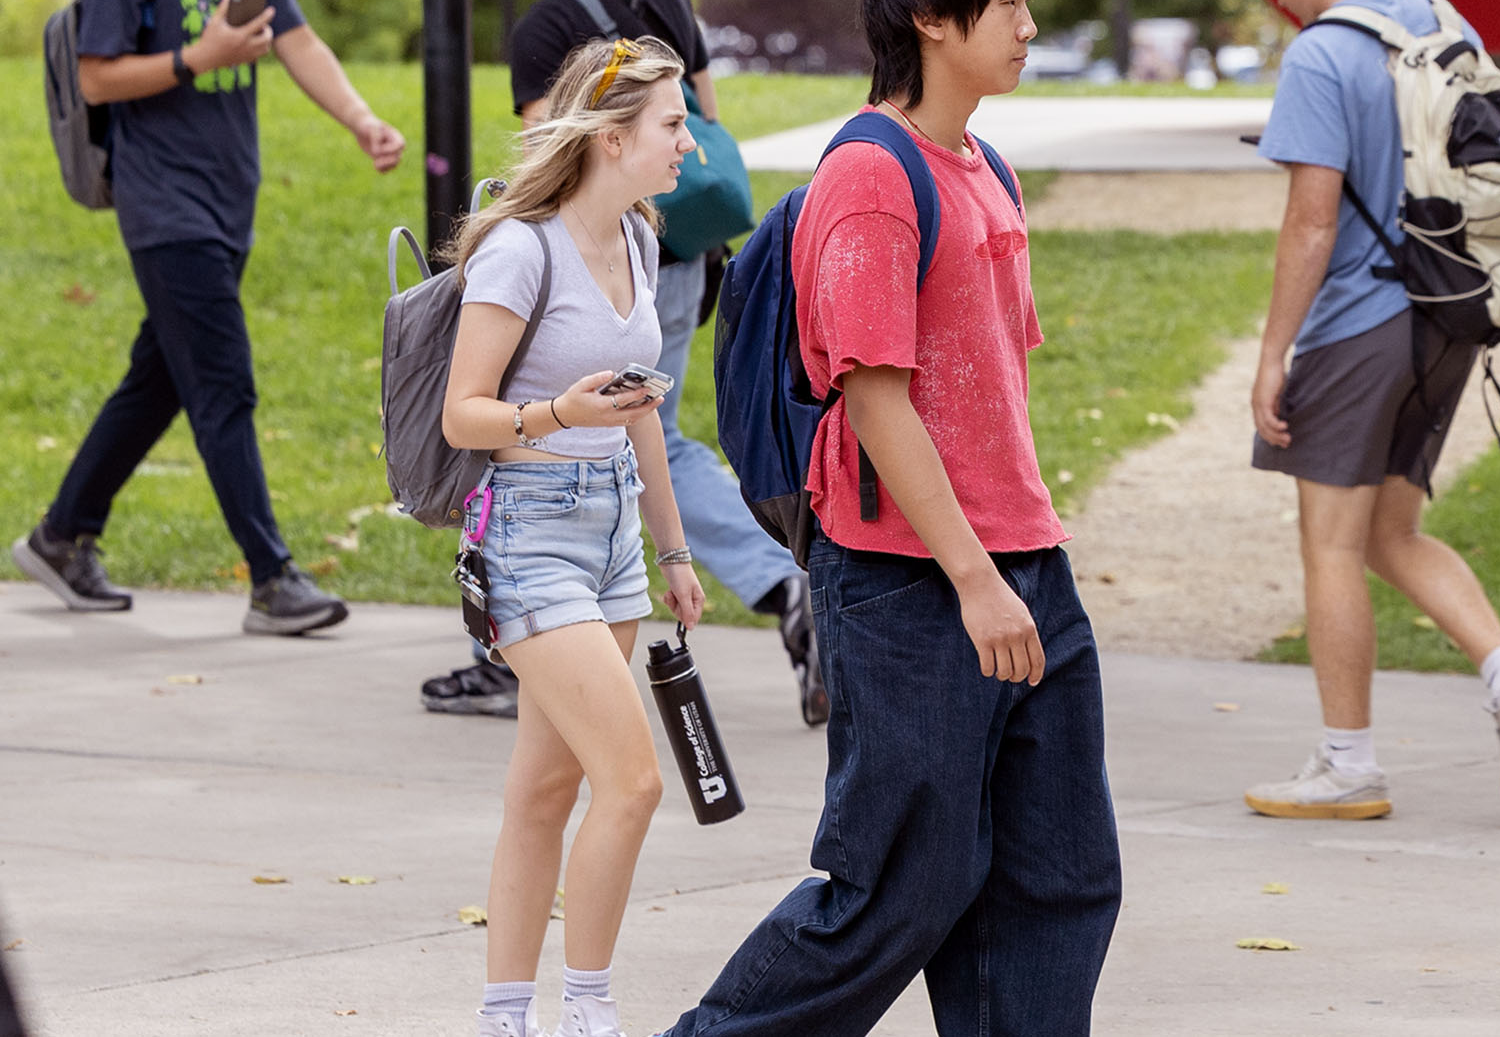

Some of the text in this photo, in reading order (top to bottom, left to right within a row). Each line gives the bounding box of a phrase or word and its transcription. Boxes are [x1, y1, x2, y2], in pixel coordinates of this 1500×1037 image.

[689, 701, 700, 718] UTAH
[680, 705, 708, 776] College of Science
[698, 726, 714, 761] UNIVERSITY
[709, 760, 718, 772] THE
[698, 775, 727, 804] U
